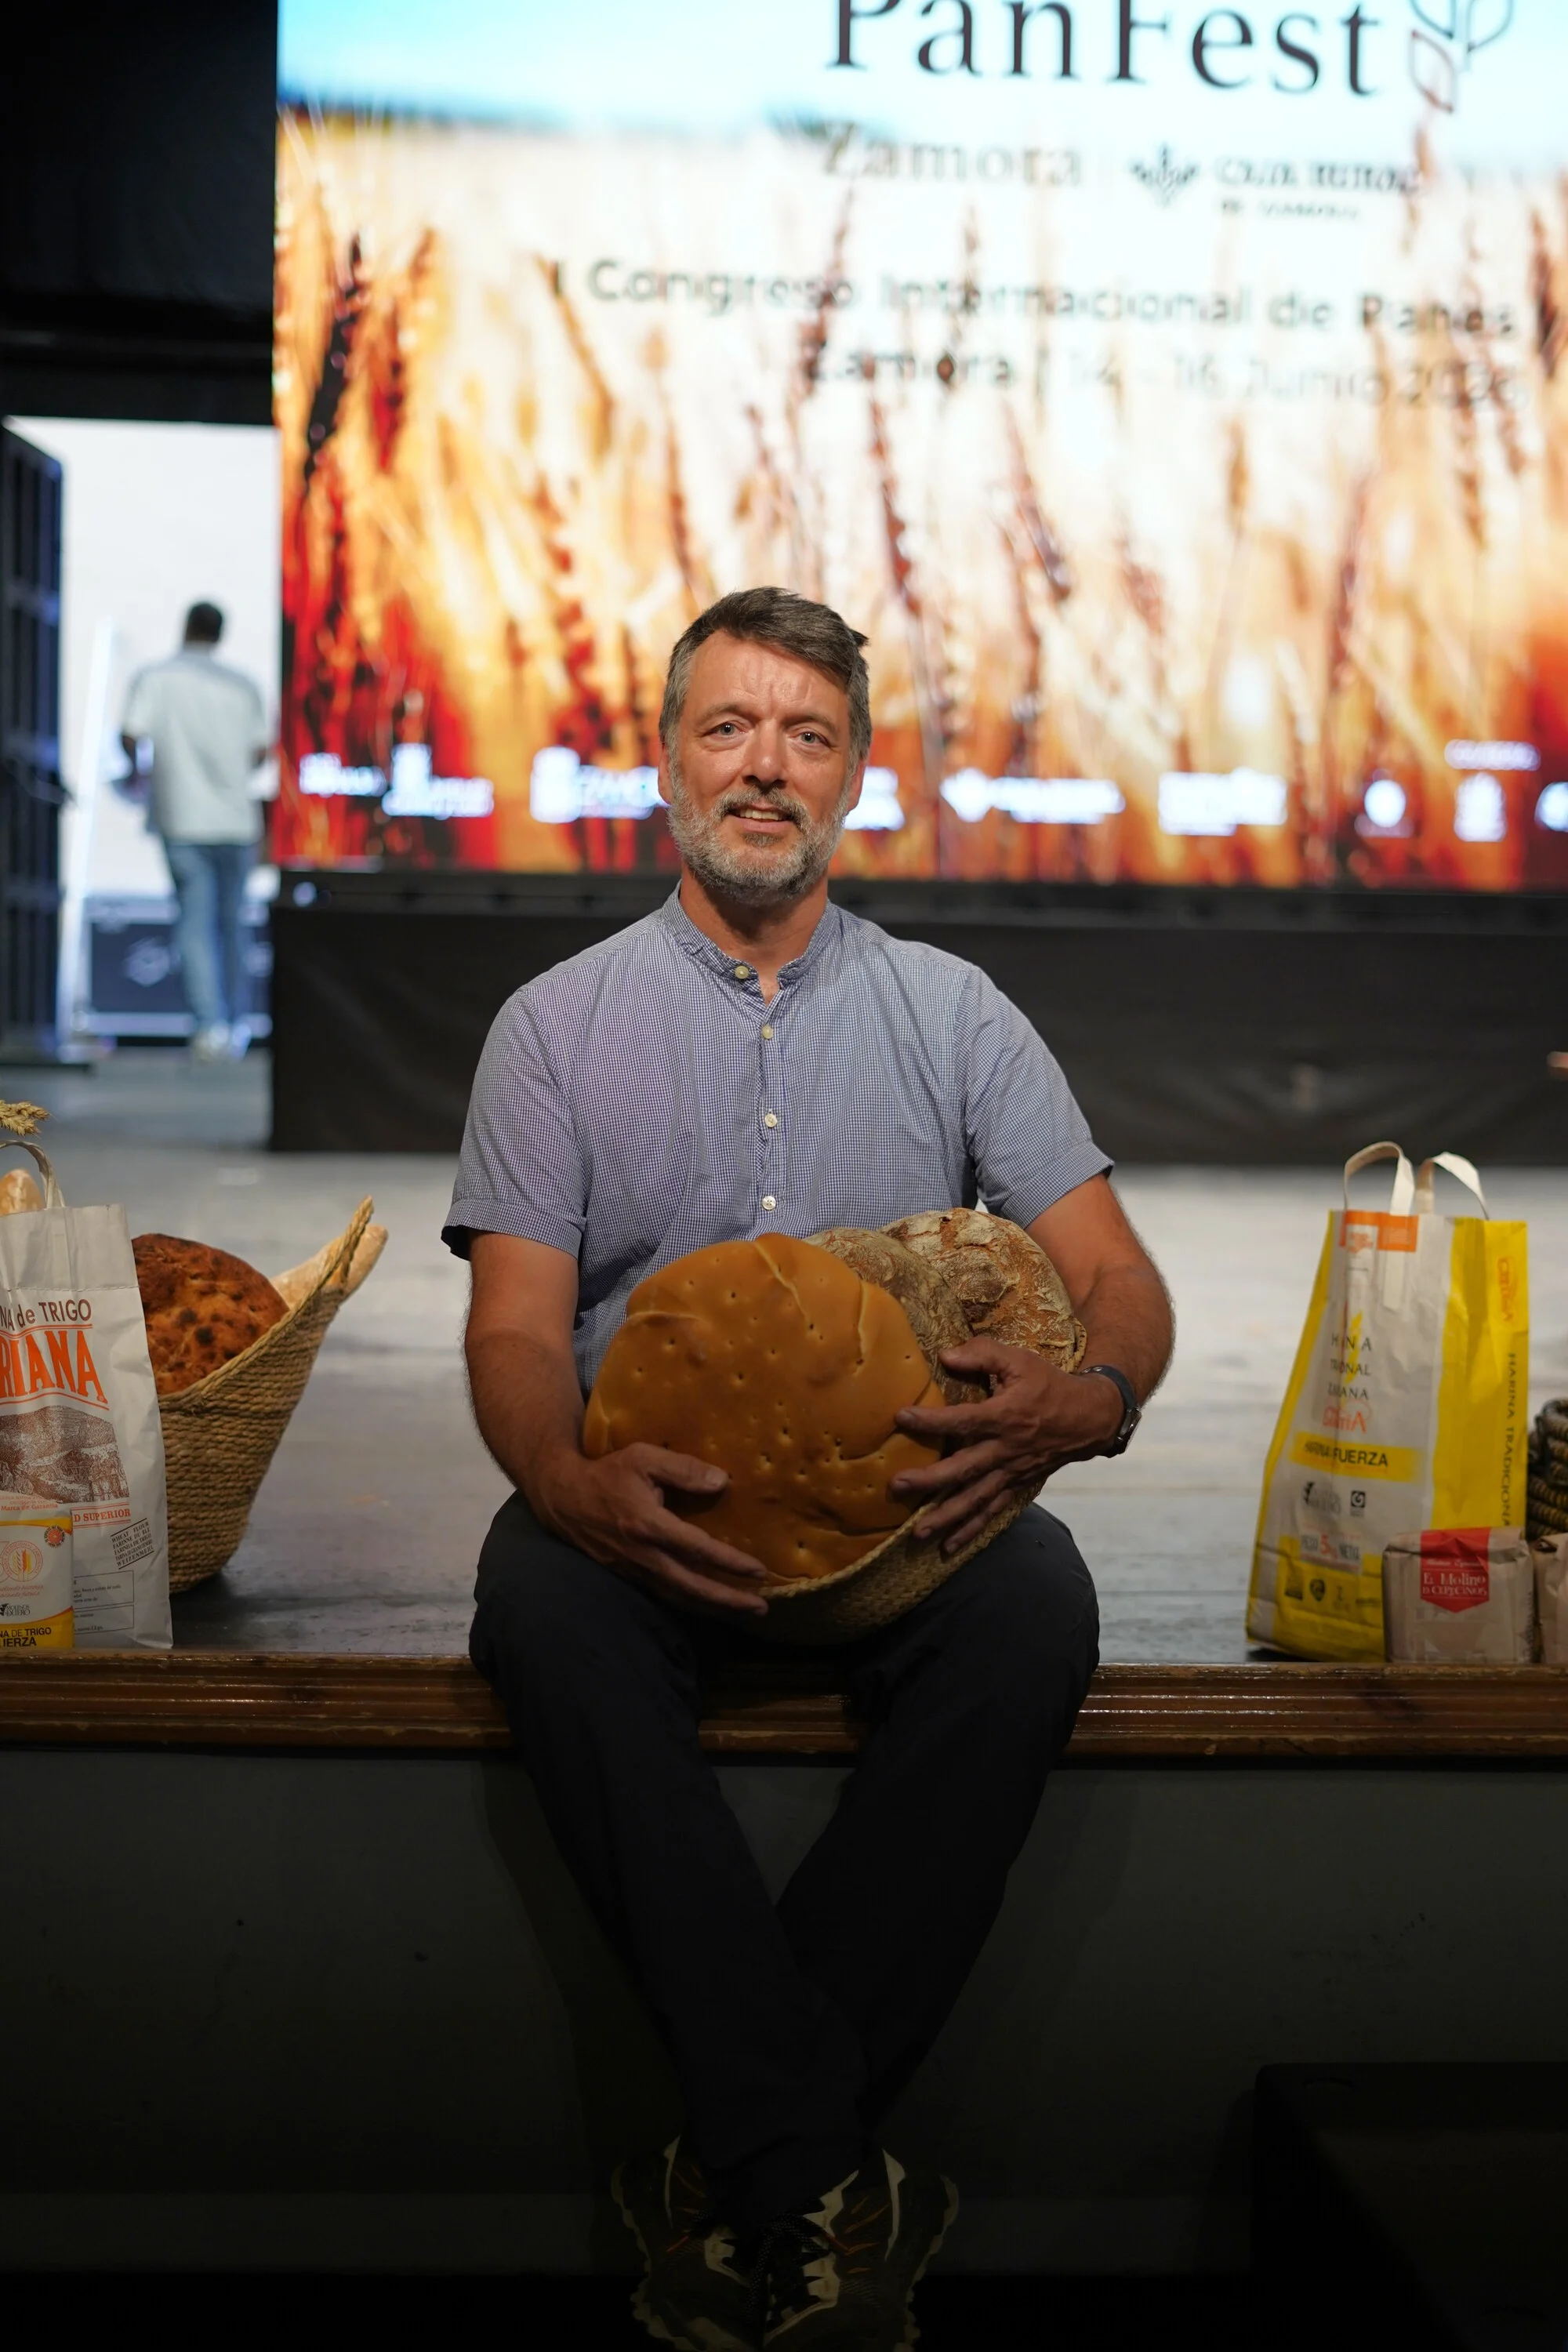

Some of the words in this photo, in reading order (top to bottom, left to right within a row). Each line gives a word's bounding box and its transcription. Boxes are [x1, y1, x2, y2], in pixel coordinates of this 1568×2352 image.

[826, 0, 1381, 96] PanFest
[1267, 290, 1337, 329] de
[17, 1304, 36, 1328] de
[38, 1298, 92, 1322] TRIGO
[1507, 1352, 1517, 1420] HARINA
[1333, 1447, 1388, 1468] FUERZA
[1501, 1427, 1515, 1527] TRADICIONA
[83, 1508, 131, 1522] SUPERIOR
[111, 1530, 129, 1543] WHEAT
[132, 1521, 149, 1534] FLOUR
[117, 1544, 154, 1567] WEIZENMEHL
[1440, 1572, 1486, 1586] Molino
[11, 1628, 23, 1637] DE
[24, 1627, 52, 1635] TRIGO
